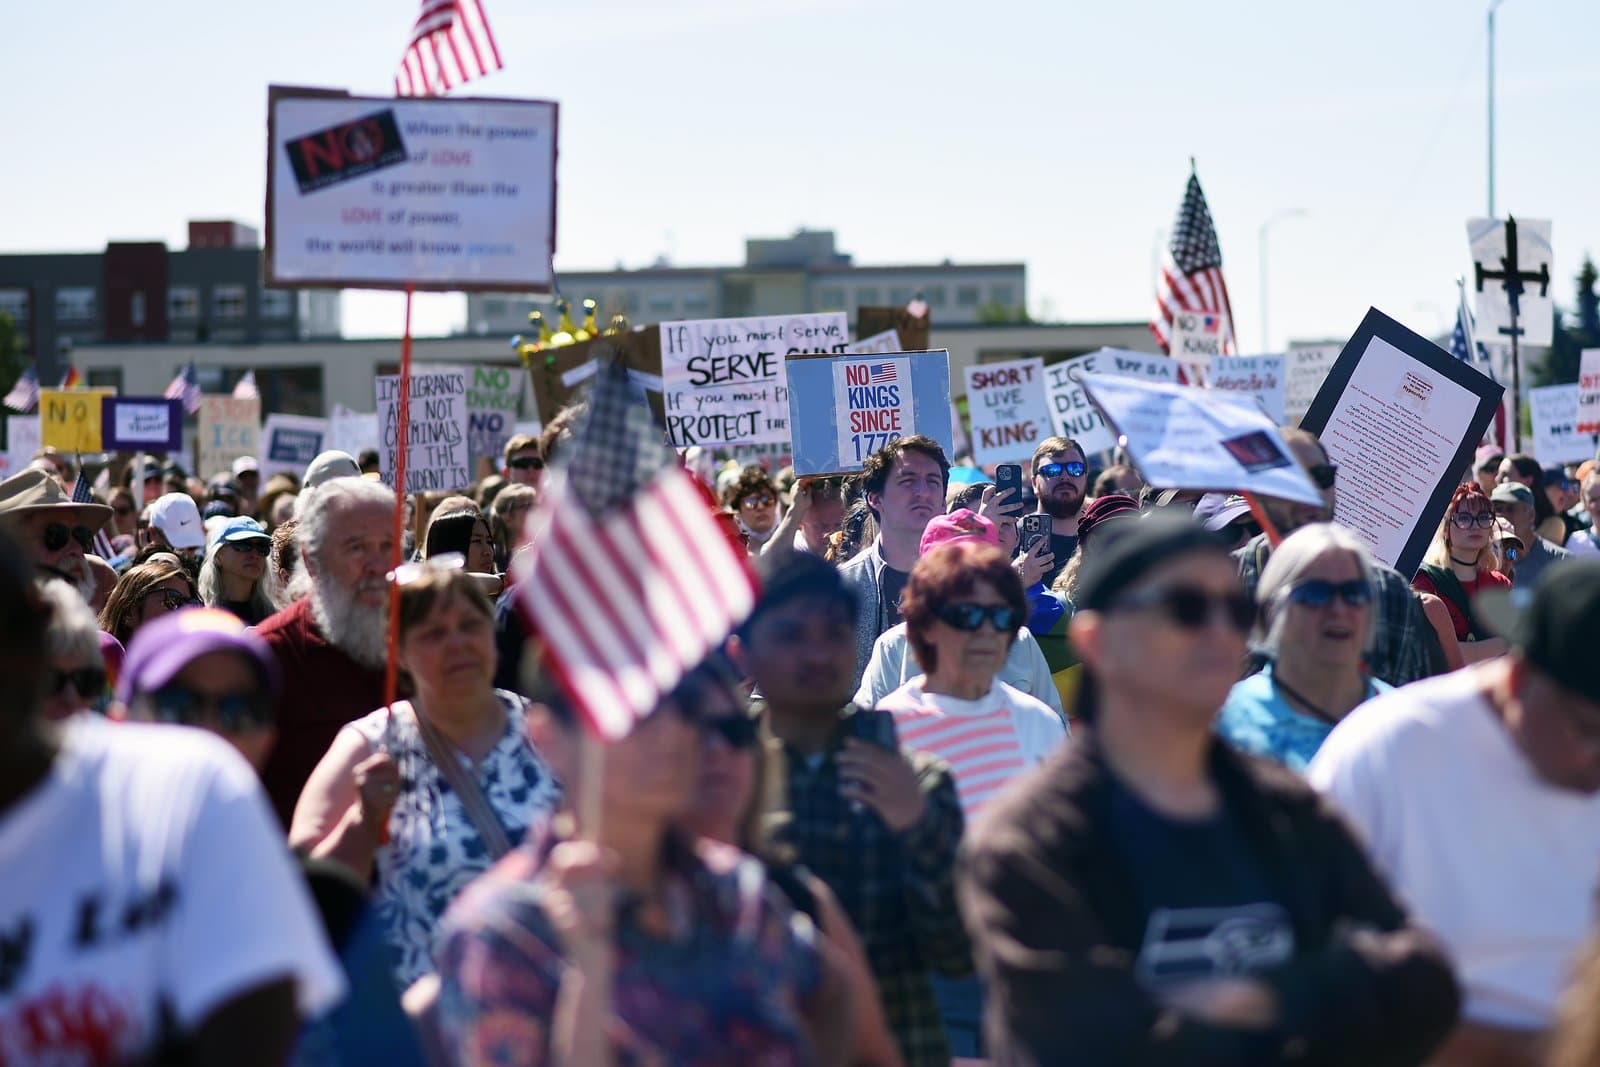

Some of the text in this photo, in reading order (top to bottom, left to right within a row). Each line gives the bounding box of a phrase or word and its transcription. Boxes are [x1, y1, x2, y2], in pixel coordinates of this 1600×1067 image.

[457, 119, 482, 135] the
[486, 123, 538, 142] power
[299, 119, 384, 178] NO
[431, 151, 472, 166] LOVE
[389, 182, 446, 198] greater
[452, 180, 489, 195] than
[493, 180, 519, 196] the
[341, 208, 384, 224] LOVE
[388, 208, 406, 223] of
[306, 237, 332, 251] the
[338, 238, 385, 254] world
[389, 238, 415, 254] will
[421, 240, 462, 254] know
[667, 326, 688, 354] If
[703, 334, 741, 359] you
[745, 325, 784, 342] must
[473, 367, 510, 389] NO
[687, 352, 778, 386] SERVE
[845, 365, 870, 387] NO
[971, 365, 1035, 390] SHORT
[666, 392, 681, 411] If
[694, 391, 724, 412] you
[733, 386, 770, 402] must
[848, 385, 901, 410] KINGS
[984, 389, 1025, 407] LIVE
[50, 402, 87, 424] NO
[425, 398, 454, 421] NOT
[850, 408, 902, 433] SINCE
[468, 412, 504, 432] NO
[666, 411, 788, 445] PROTECT THE
[425, 445, 460, 466] THE
[451, 468, 469, 489] IS
